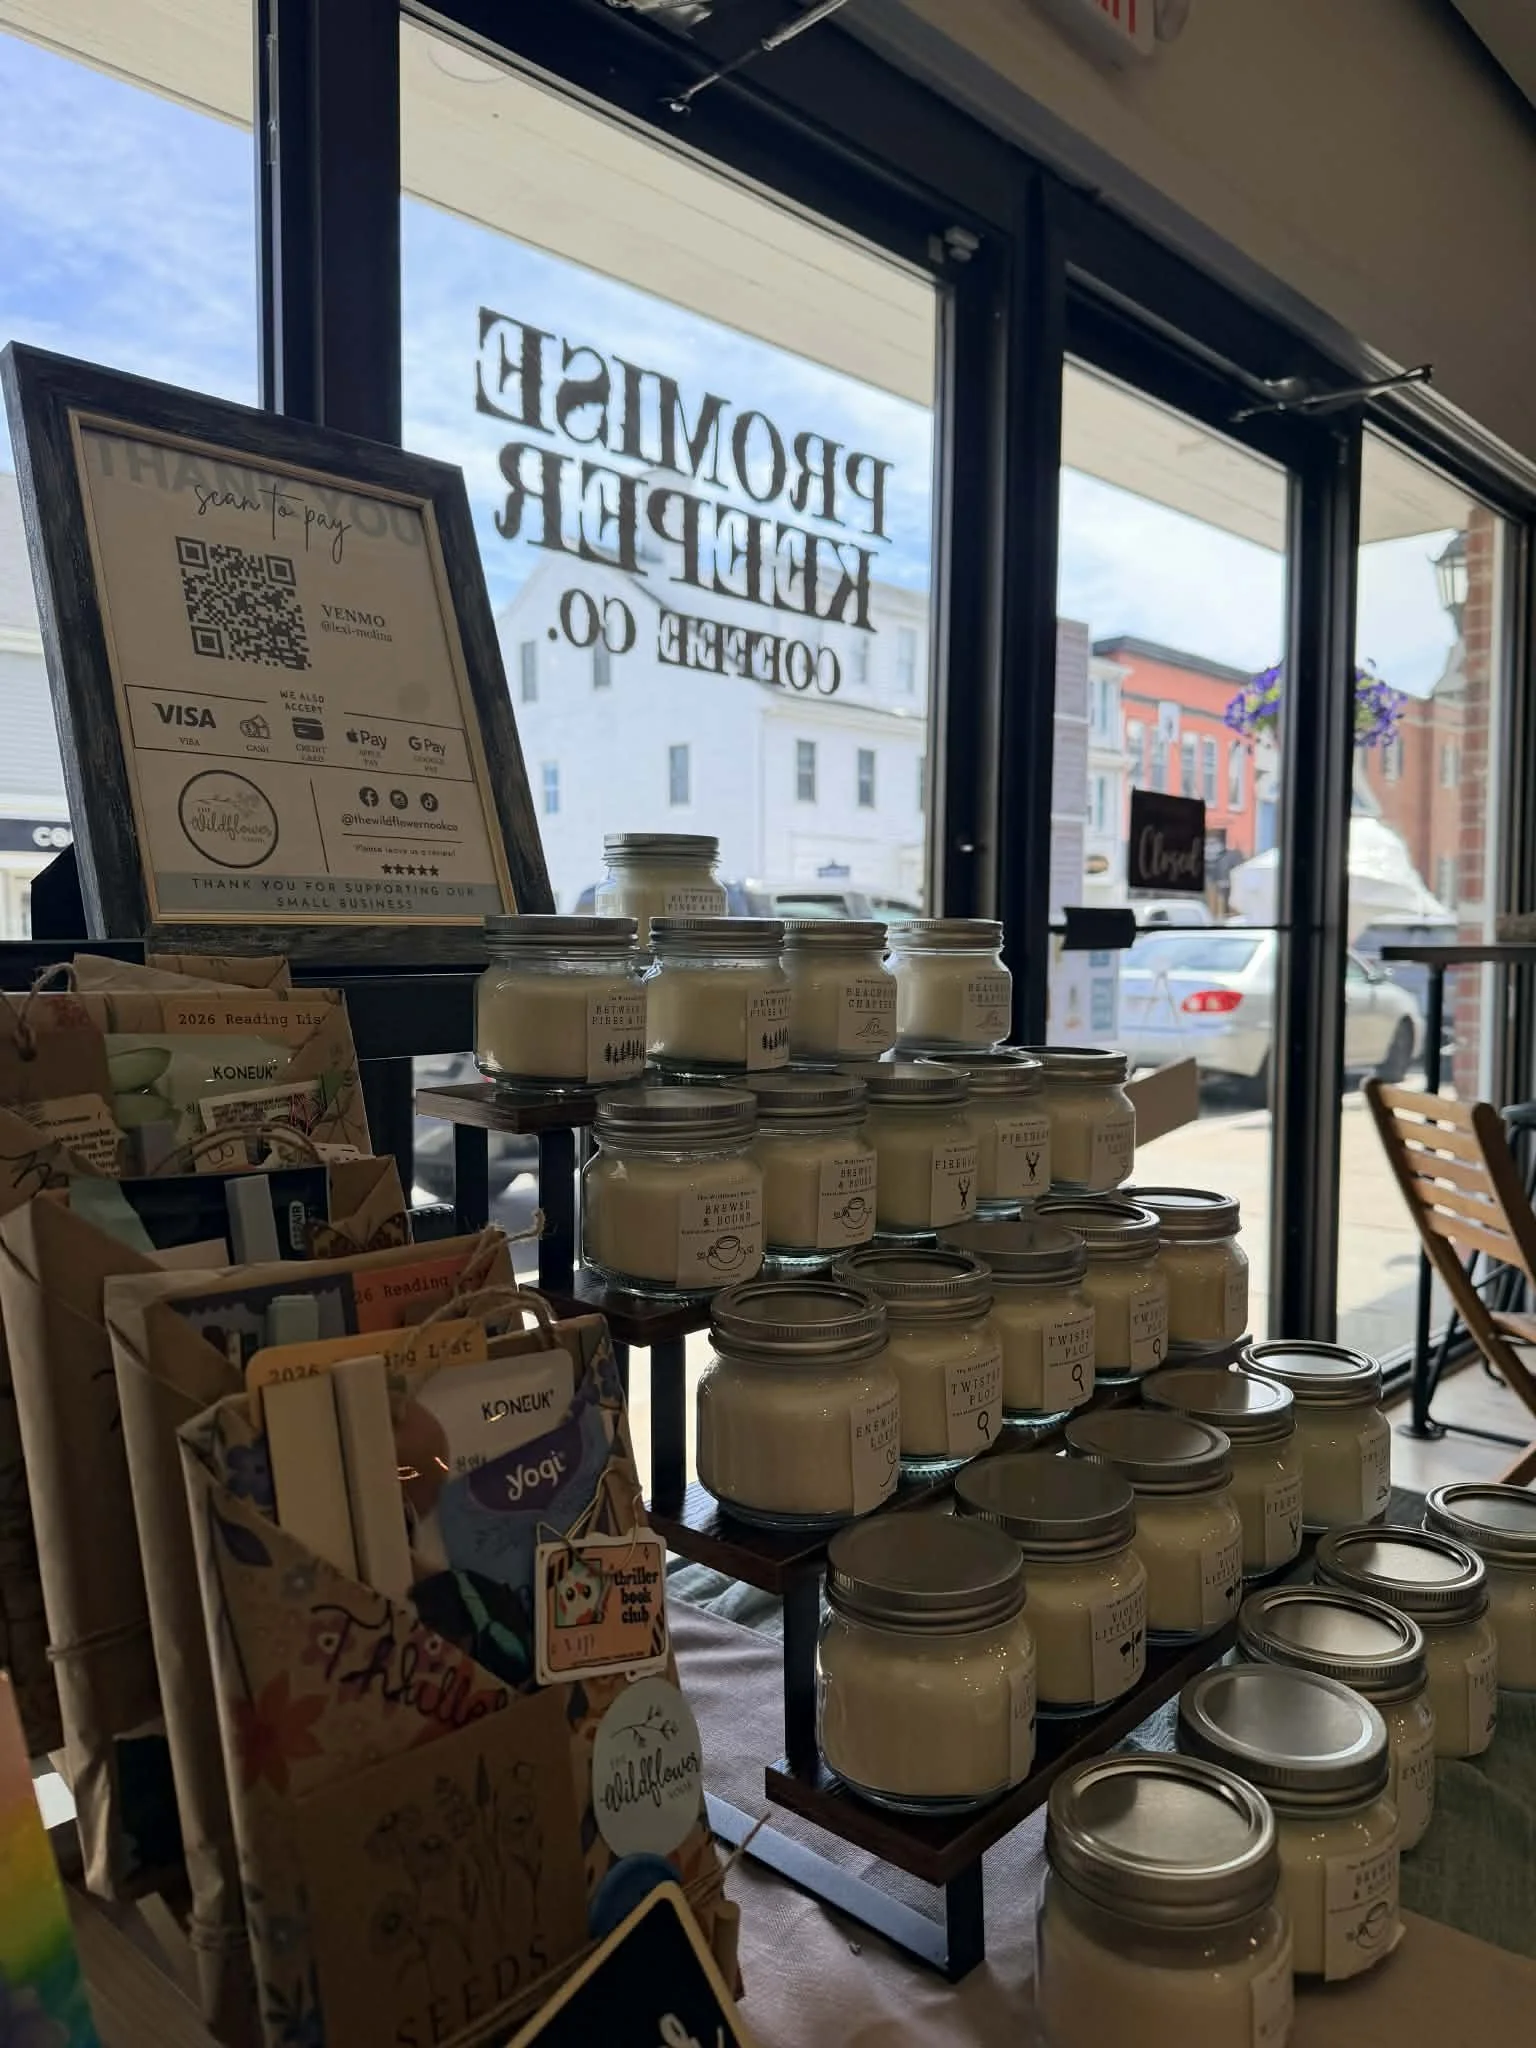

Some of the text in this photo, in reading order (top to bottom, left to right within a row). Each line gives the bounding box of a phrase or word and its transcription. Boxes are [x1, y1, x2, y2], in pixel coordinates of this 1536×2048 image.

[193, 482, 352, 565] scan to pay
[321, 603, 386, 629] VENMO
[280, 690, 325, 704] WE ALSO
[152, 702, 217, 729] VISA
[285, 703, 323, 714] ACCEPT
[360, 730, 387, 749] Pay
[423, 739, 446, 756] Pay
[191, 878, 251, 889] THANK
[261, 880, 296, 892] YOU
[305, 881, 337, 893] FOR
[345, 883, 440, 897] SUPPORTING
[276, 897, 414, 911] SMALL BUSINESS
[178, 1014, 216, 1026] 2026
[226, 1013, 288, 1028] Reading
[383, 1273, 449, 1298] Reading
[505, 1450, 566, 1501] yogi
[614, 1566, 659, 1586] thriller
[621, 1588, 652, 1605] book
[621, 1605, 649, 1624] club
[601, 1748, 700, 1813] Wildflower
